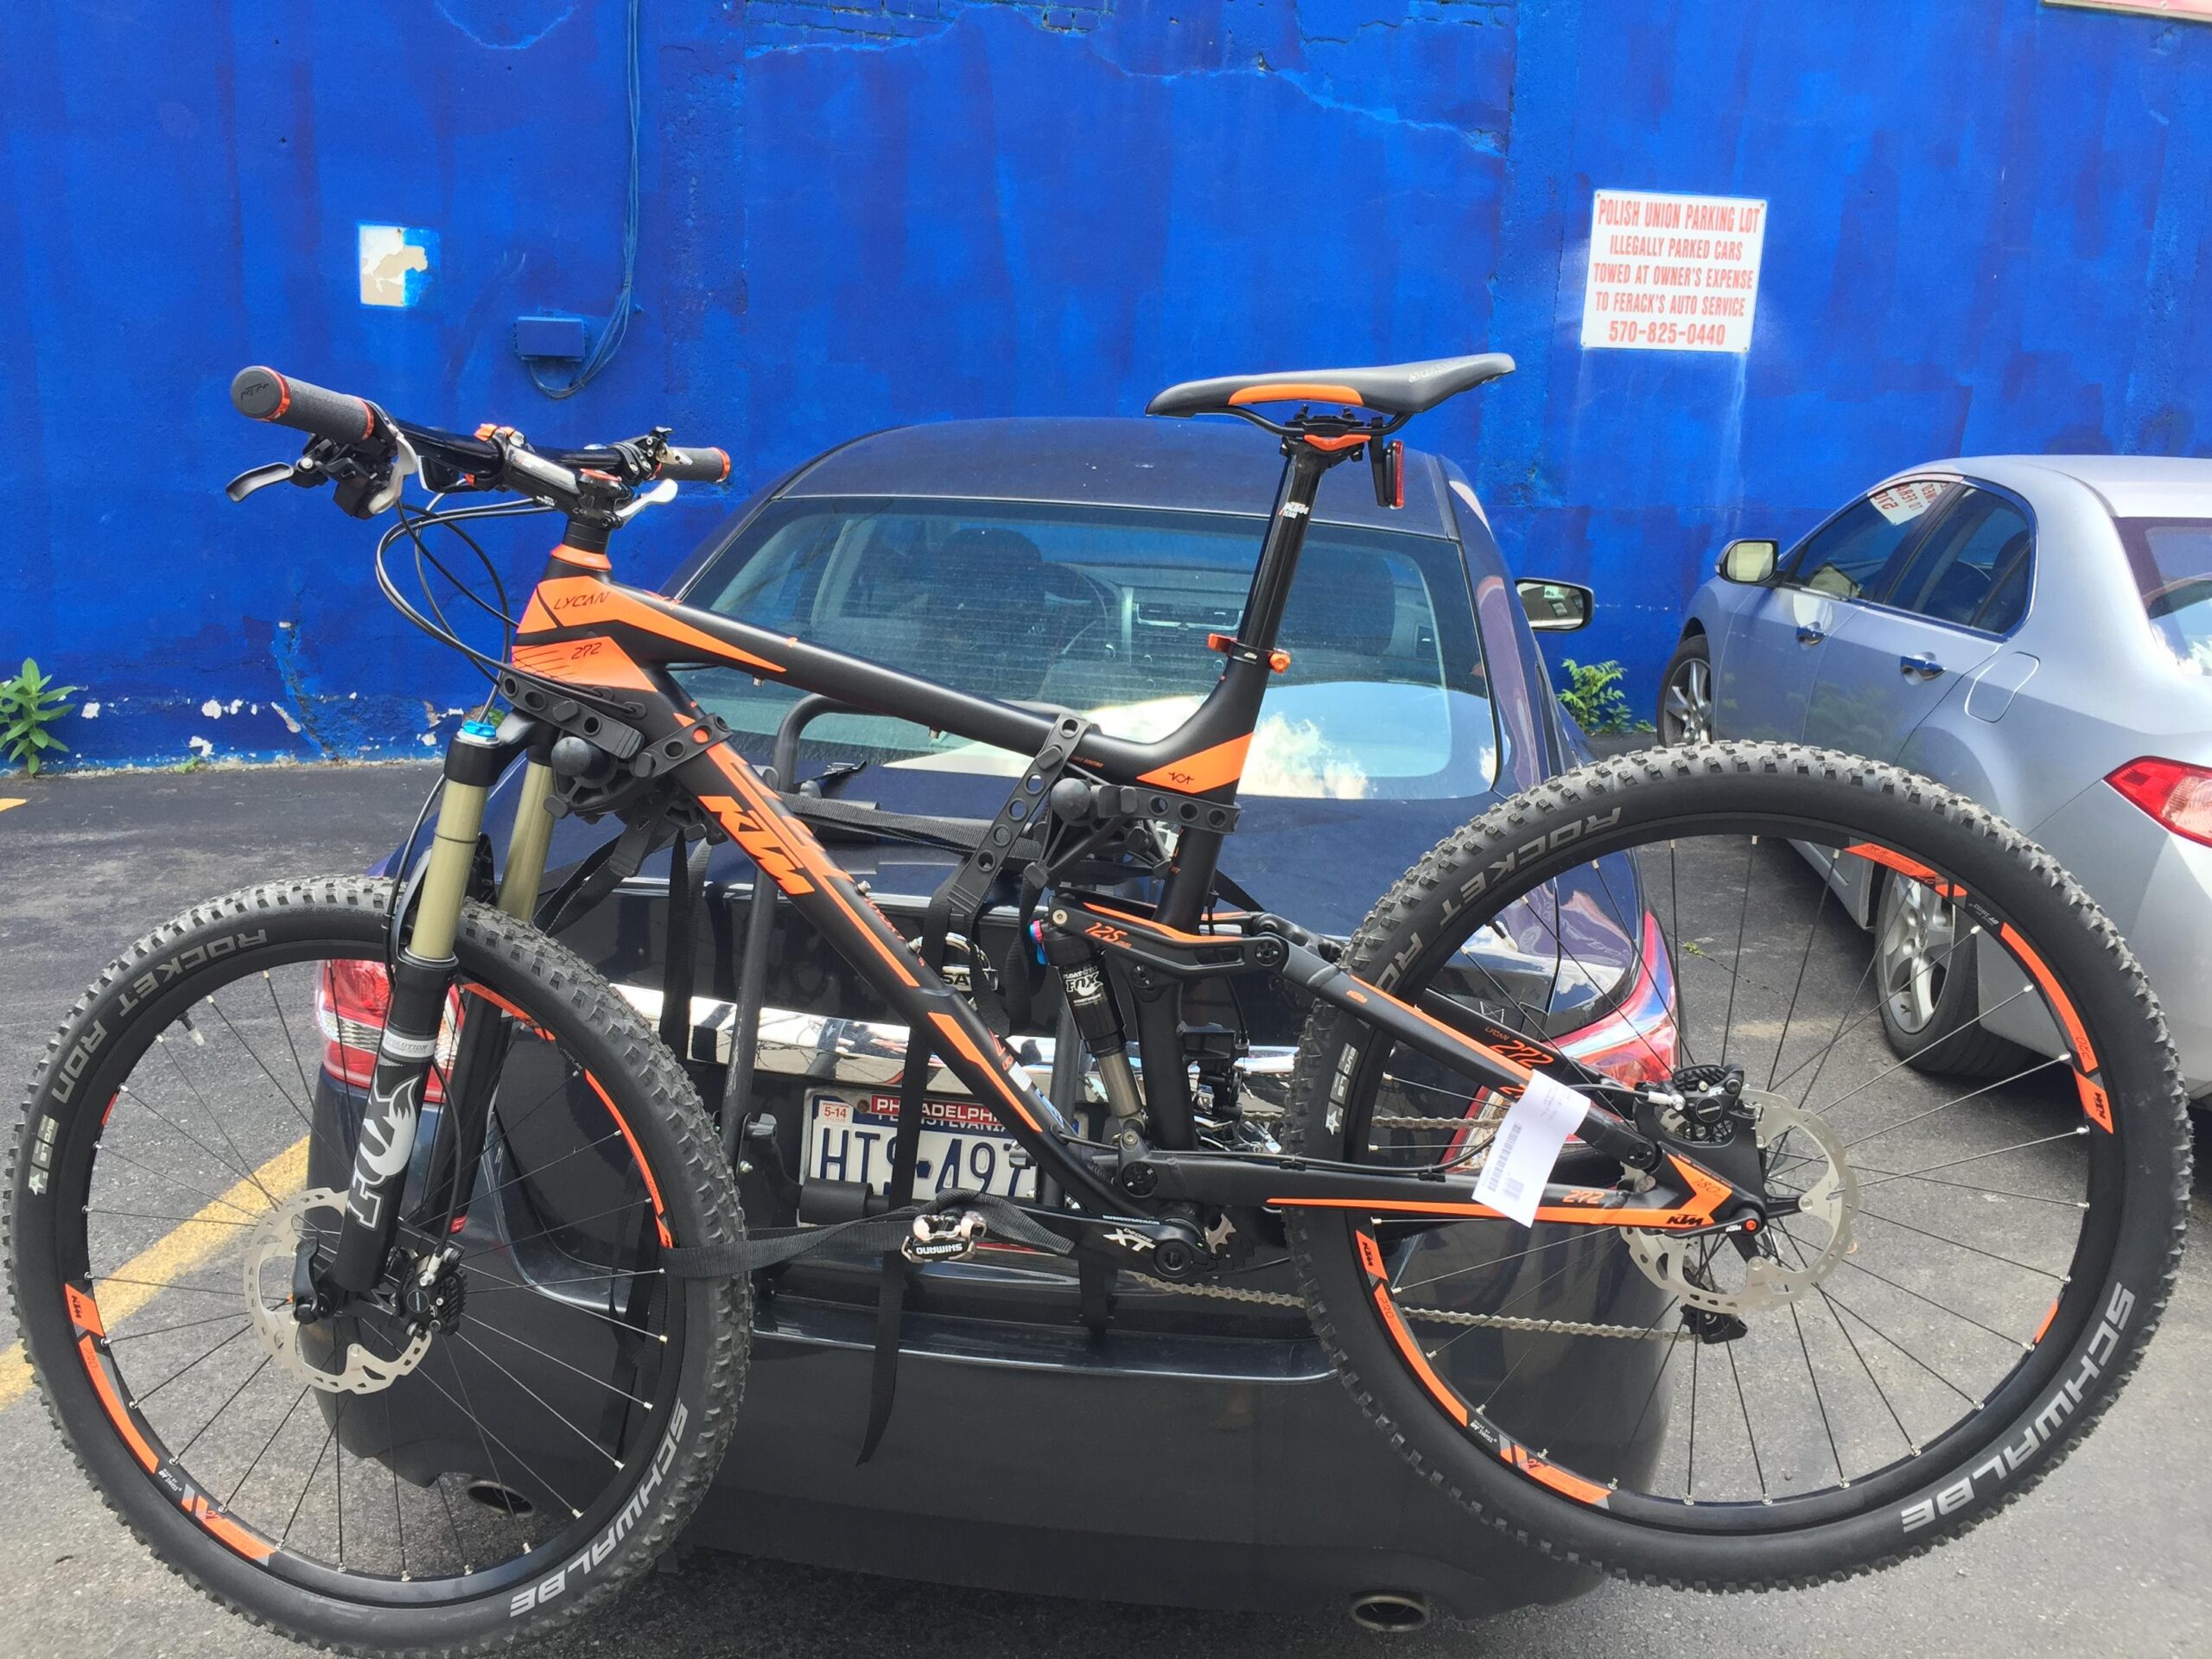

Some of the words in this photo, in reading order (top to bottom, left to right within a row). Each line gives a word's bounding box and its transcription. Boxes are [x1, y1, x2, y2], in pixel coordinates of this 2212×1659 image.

[1599, 199, 1640, 226] POLISH
[1644, 201, 1681, 229] UNION
[1685, 204, 1735, 232] PARKING
[1738, 207, 1761, 233] LOT
[1610, 234, 1665, 257] ILLEGALLY
[1668, 238, 1711, 259] PARKED
[1713, 240, 1743, 261] CARS
[1593, 263, 1631, 283] TOWED
[1635, 265, 1649, 284] AT
[1653, 265, 1702, 287] OWNER'S
[1706, 269, 1754, 289] EXPENSE
[1596, 291, 1610, 311] TO
[1612, 292, 1666, 314] FERACK'S
[1669, 295, 1697, 315] AUTO
[1701, 296, 1745, 317] SERVICE
[1608, 321, 1726, 346] 570-825-0440
[554, 591, 611, 610] LYCAN
[571, 643, 602, 660] 272
[698, 796, 815, 894] KTM
[1440, 807, 1622, 927] ROCKET
[118, 929, 268, 1016] ROCKET
[1374, 931, 1424, 994] RO
[1065, 971, 1103, 996] FOX
[51, 1020, 108, 1103] RON
[1489, 1039, 1554, 1068] 272
[824, 1107, 847, 1118] 5-14
[877, 1098, 998, 1122] PHADELPH
[1563, 1190, 1605, 1204] 272
[1666, 1213, 1704, 1226] KTM
[1103, 1228, 1156, 1251] XT
[1123, 1228, 1154, 1243] DEORE
[916, 1243, 963, 1255] SHIMANO
[1901, 1281, 2136, 1534] SCHWALBE
[510, 1396, 689, 1618] SCHWALBE
